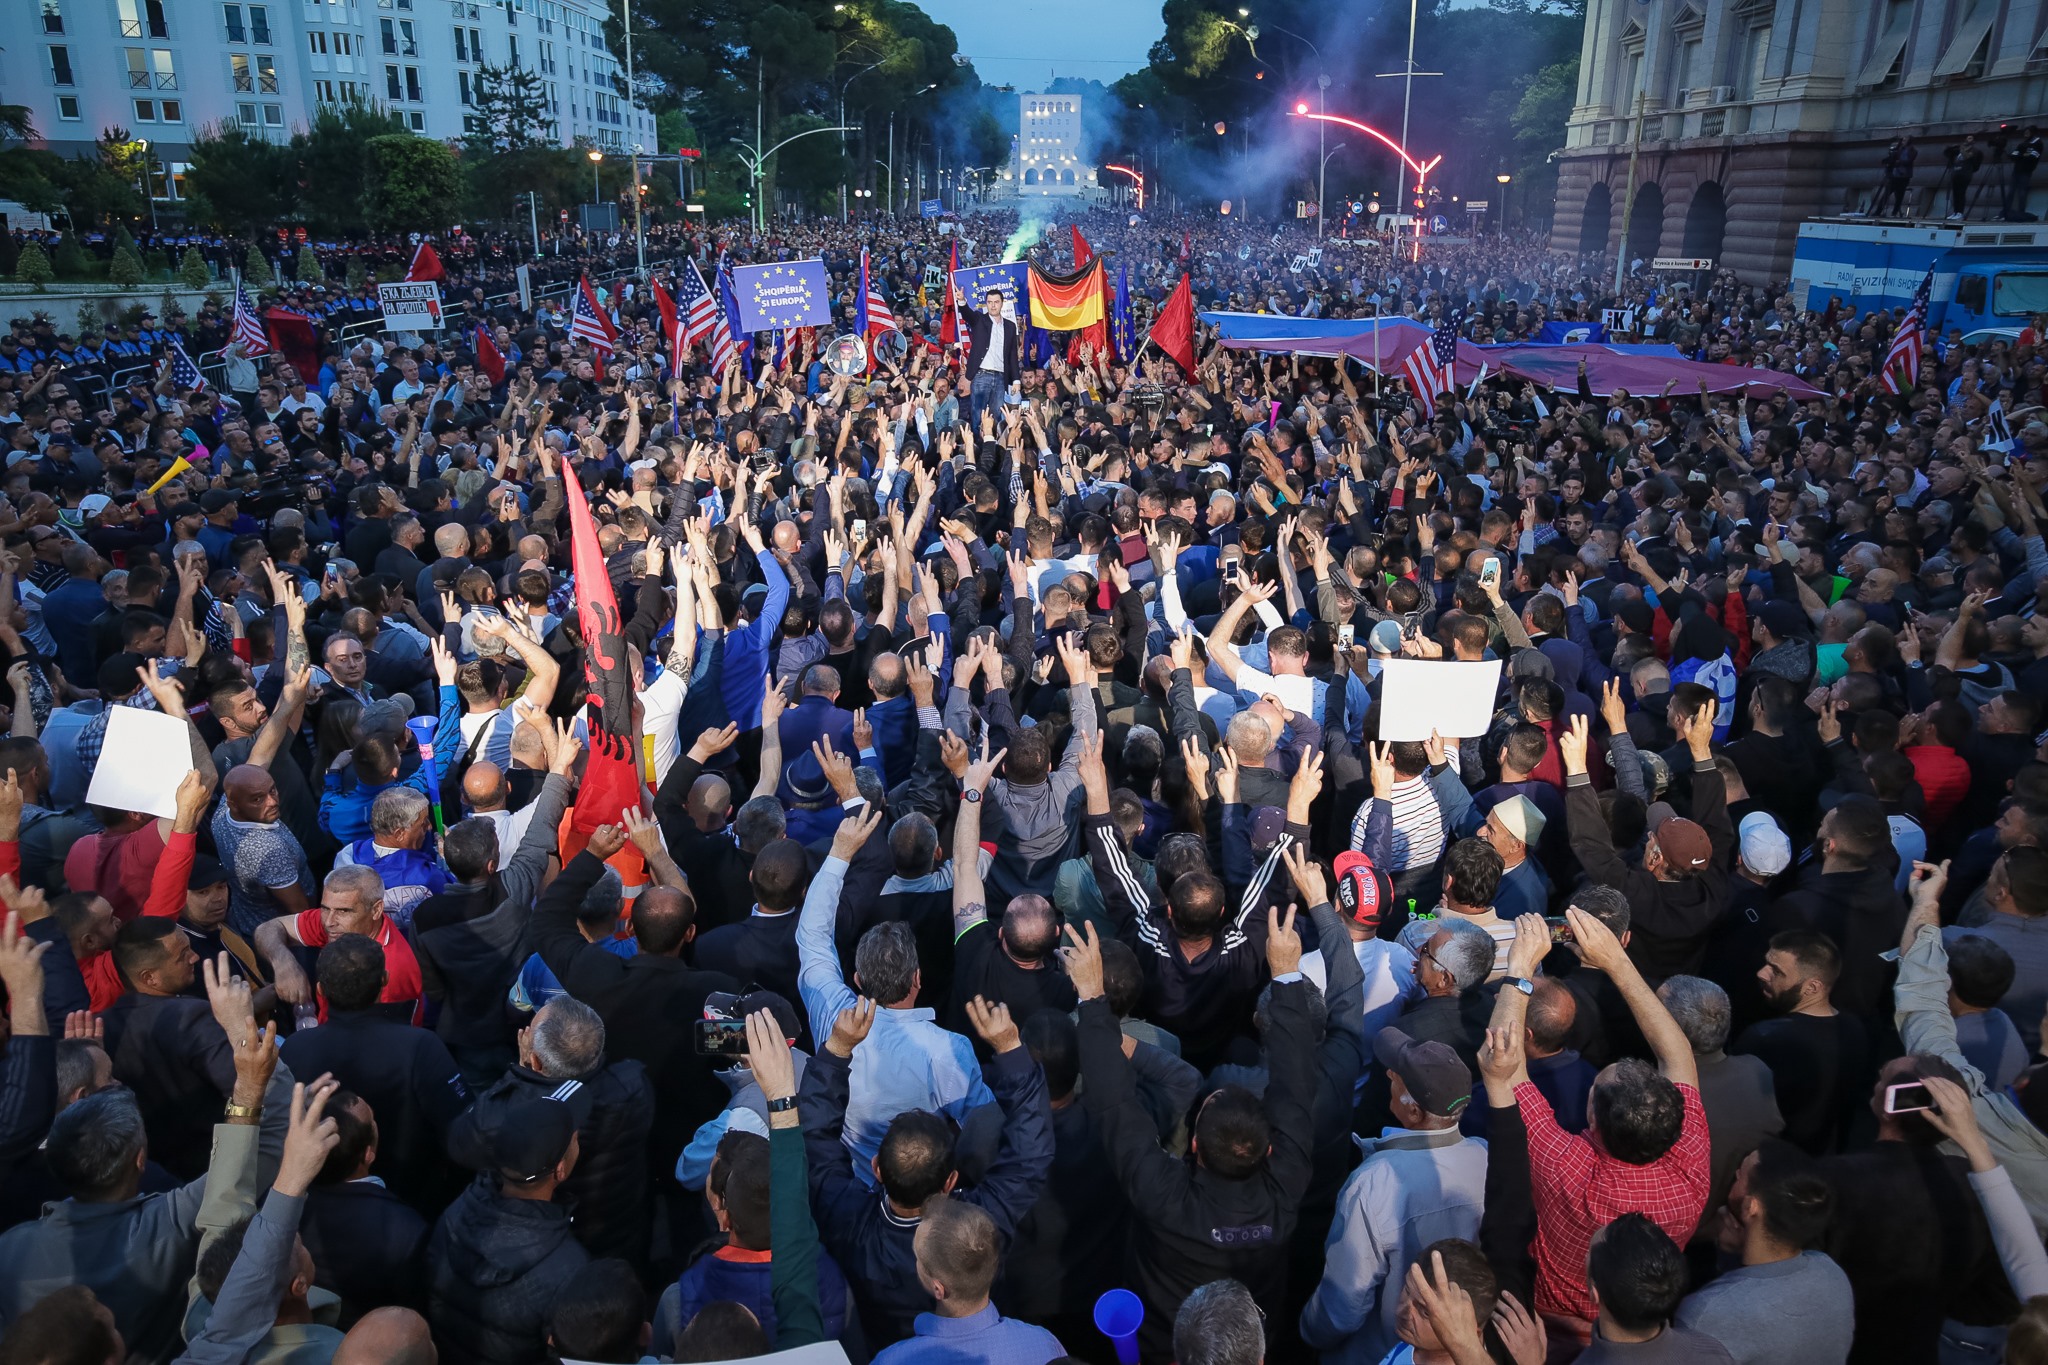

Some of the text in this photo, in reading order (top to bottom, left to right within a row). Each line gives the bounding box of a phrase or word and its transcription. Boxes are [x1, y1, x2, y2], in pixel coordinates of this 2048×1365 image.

[1293, 258, 1307, 270] iK
[1309, 252, 1321, 264] iK
[926, 269, 940, 285] iK
[381, 285, 433, 300] S'KA ZGJEDHJE
[759, 285, 805, 297] SHQIPËRIA
[761, 296, 806, 308] SI EUROPA
[978, 295, 986, 303] SI
[385, 302, 396, 315] PA
[1607, 311, 1627, 330] iK
[1341, 877, 1355, 907] NYC
[1361, 876, 1376, 906] YORK
